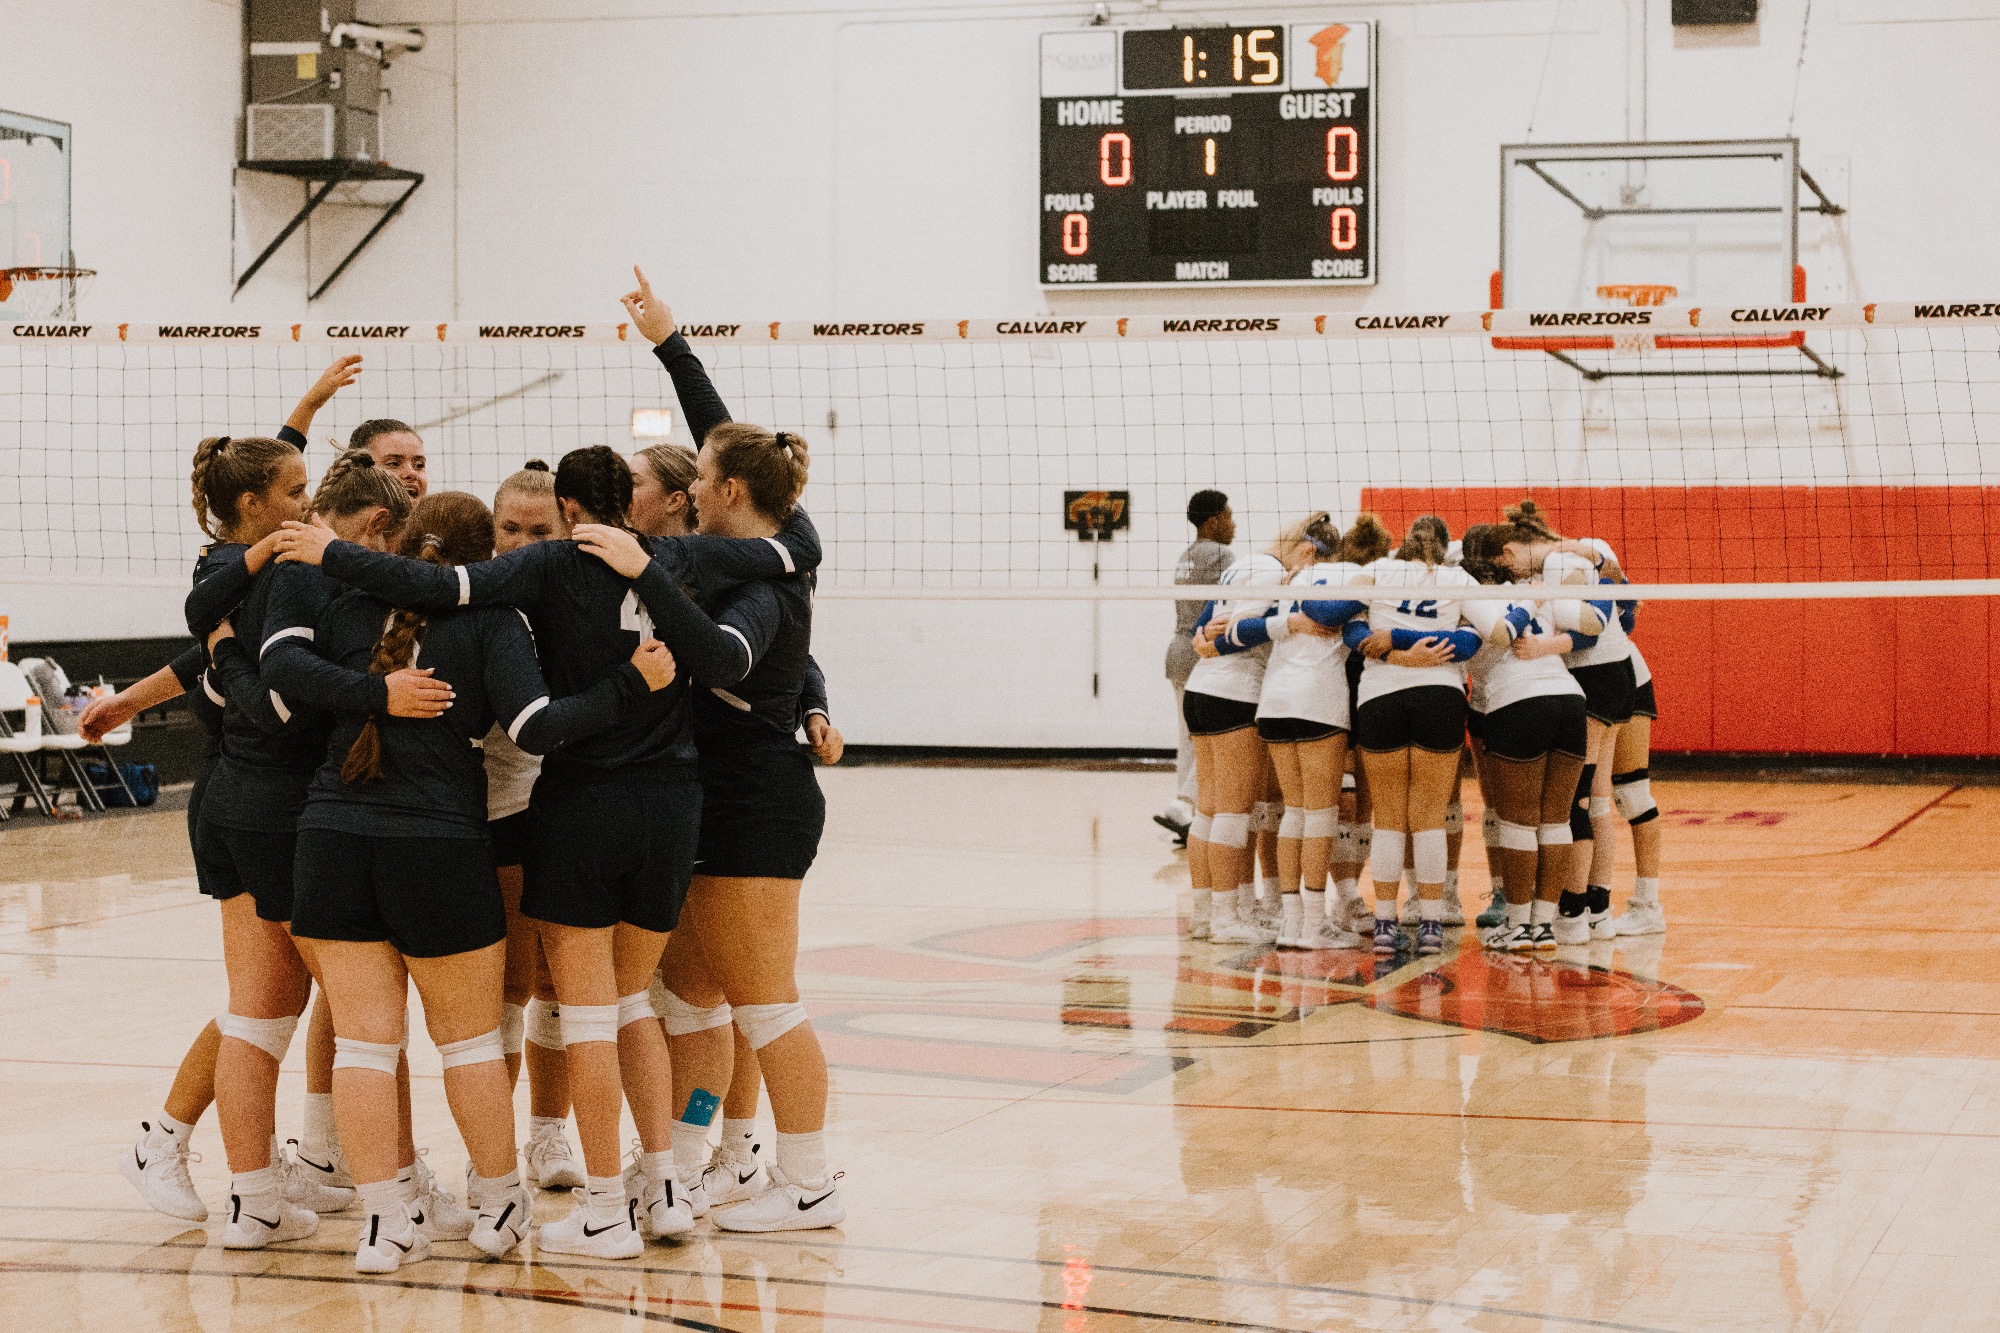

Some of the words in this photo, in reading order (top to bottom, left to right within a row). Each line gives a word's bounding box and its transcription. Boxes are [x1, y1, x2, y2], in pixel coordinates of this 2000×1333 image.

[1183, 29, 1278, 83] 1:15
[1057, 100, 1124, 126] HOME
[1279, 93, 1356, 120] GUEST
[1174, 115, 1232, 134] PERIOD
[1100, 132, 1131, 186] 0
[1204, 138, 1216, 176] 1
[1326, 126, 1358, 180] 0
[1044, 193, 1095, 211] FOULS
[1146, 190, 1208, 210] PLAYER
[1217, 189, 1259, 208] FOUL
[1312, 187, 1364, 206] FOULS
[1063, 213, 1088, 256] 0
[1331, 207, 1357, 250] 0
[1047, 264, 1098, 282] SCORE
[1175, 262, 1230, 280] MATCH
[1311, 259, 1364, 277] SCORE
[12, 325, 92, 338] CALVARY
[158, 325, 261, 338] WARRIORS
[326, 325, 410, 338] CALVARY
[479, 325, 586, 338] WARRIORS
[676, 324, 741, 337] LVARY
[813, 322, 925, 337] WARRIORS
[996, 321, 1087, 335] CALVARY
[1163, 318, 1280, 333] WARRIORS
[1354, 315, 1450, 330] CALVARY
[1529, 311, 1653, 327] WARRIORS
[1730, 307, 1831, 323] CALVARY
